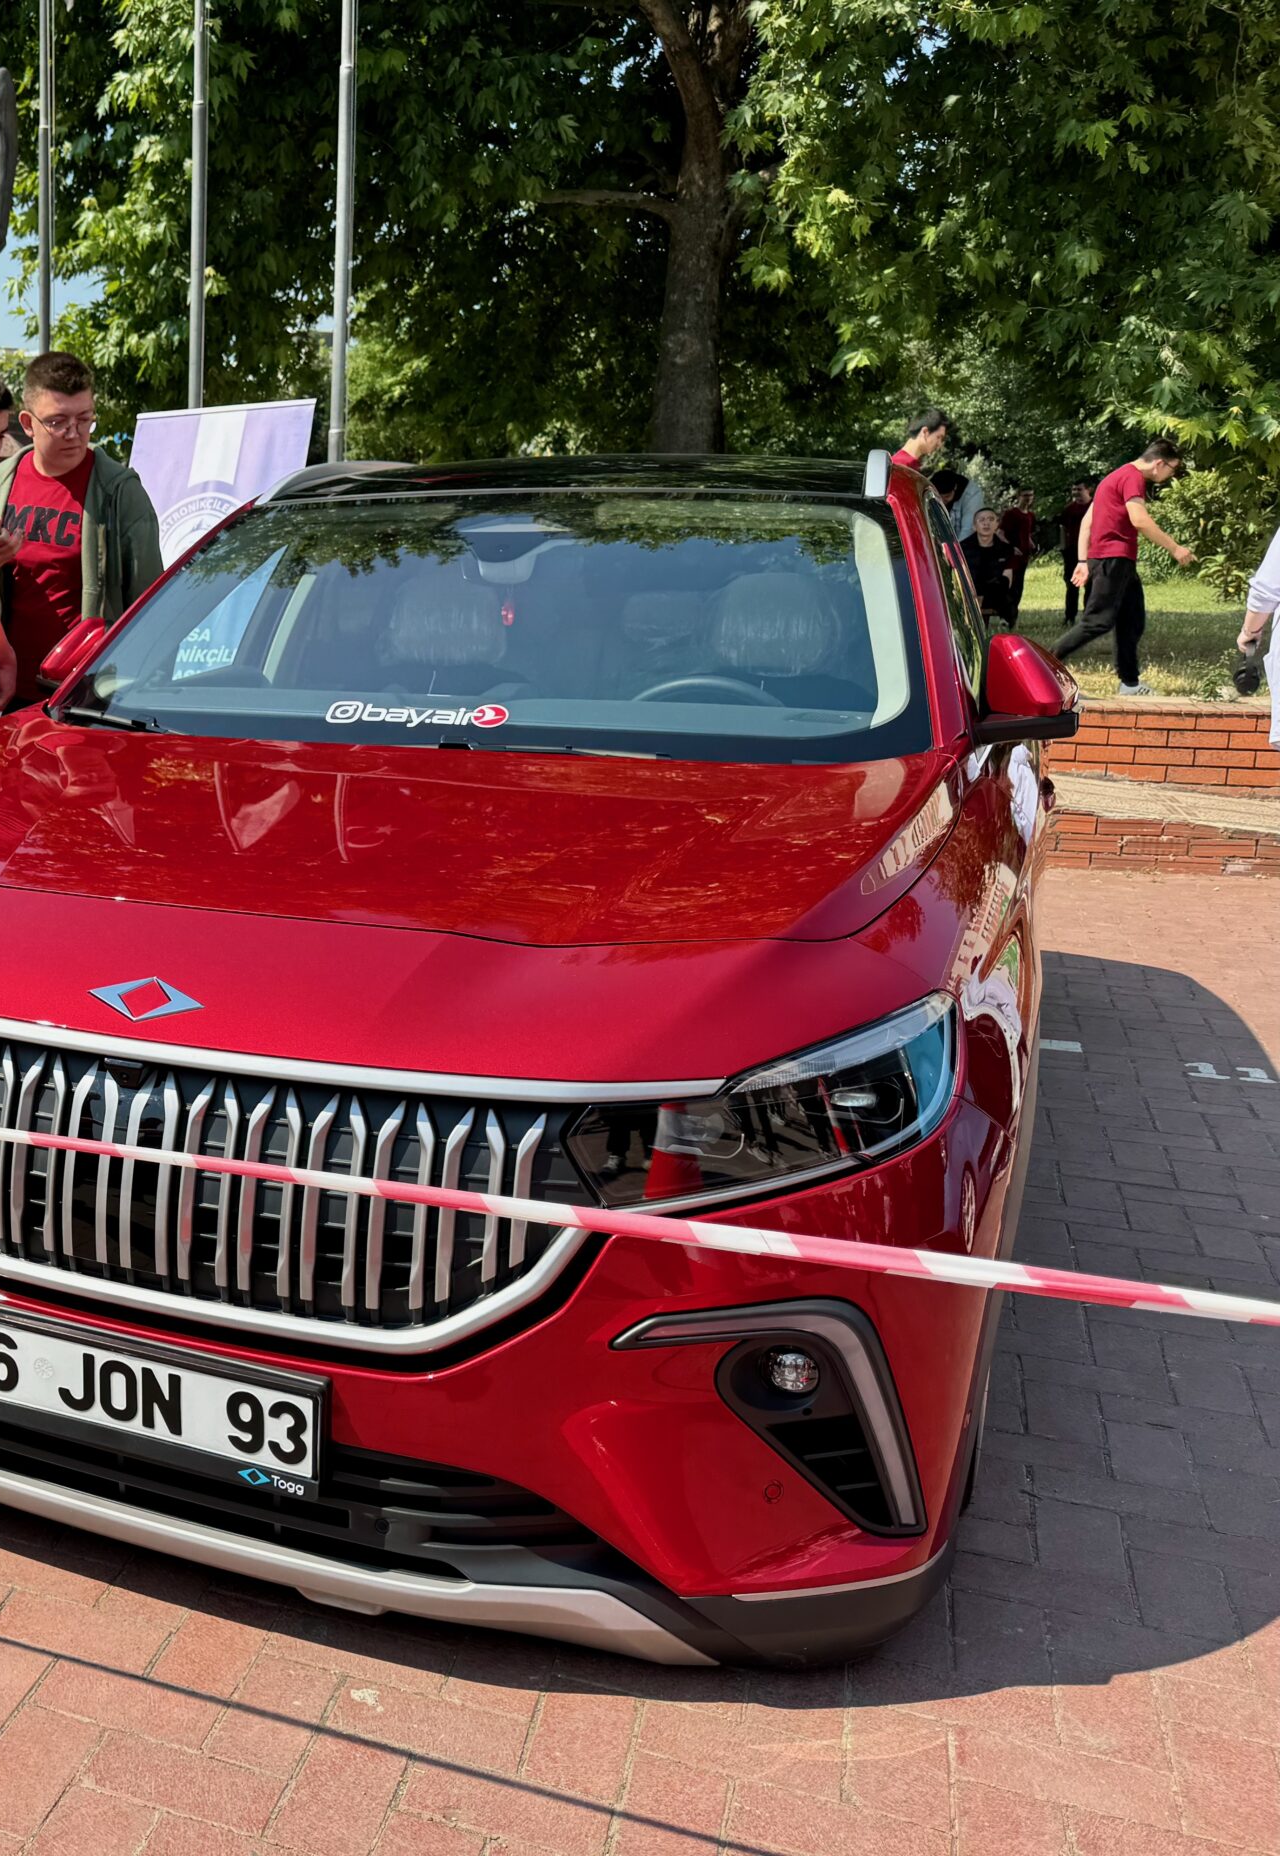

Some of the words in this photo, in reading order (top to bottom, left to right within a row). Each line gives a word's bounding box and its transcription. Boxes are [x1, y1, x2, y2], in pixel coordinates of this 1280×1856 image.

[182, 627, 211, 642] SA
[176, 645, 235, 667] NİKÇİL
[58, 1352, 182, 1436] JON
[225, 1391, 308, 1465] 93
[270, 1474, 305, 1497] Togg
